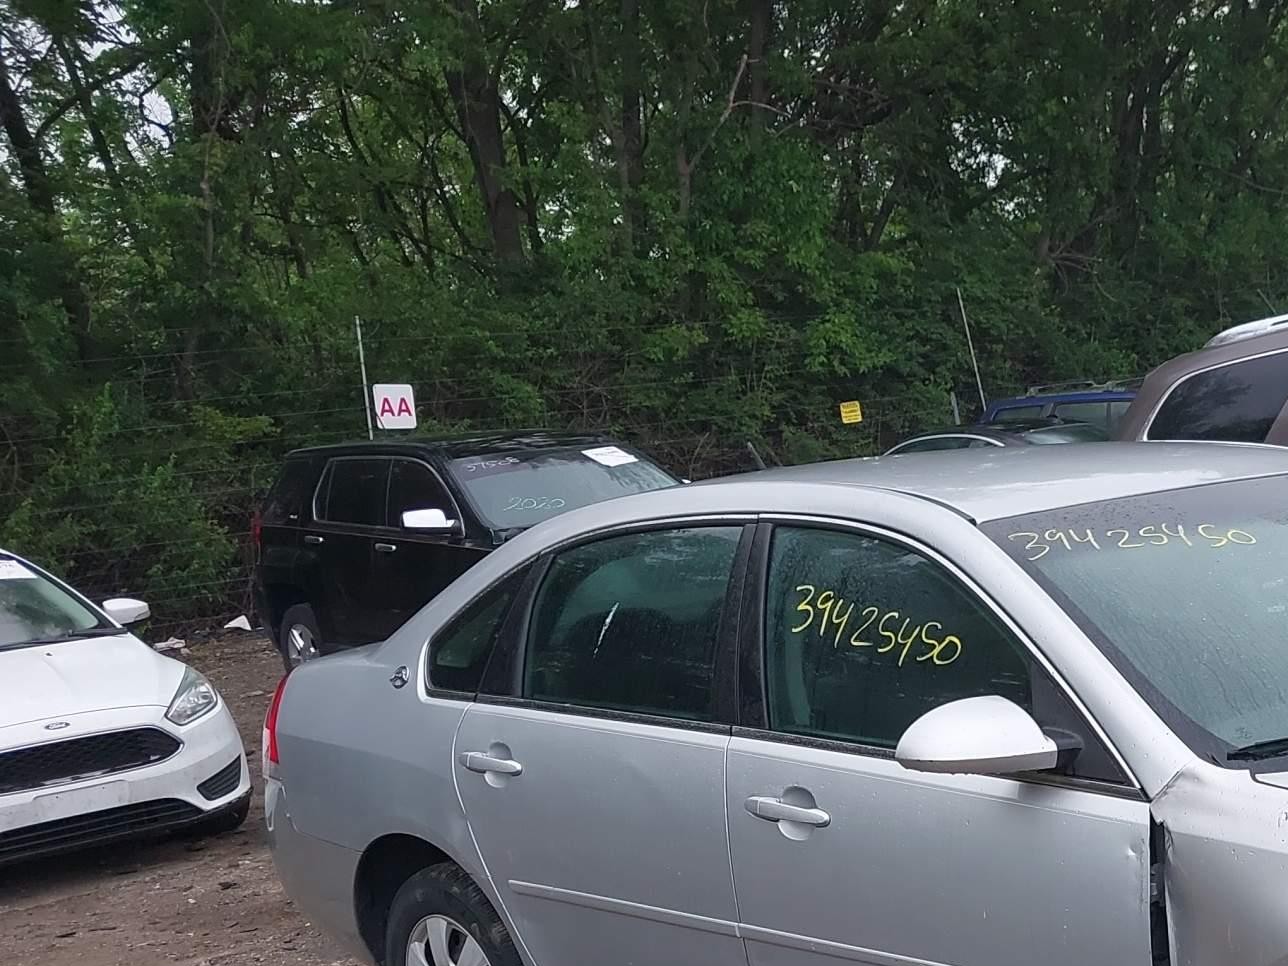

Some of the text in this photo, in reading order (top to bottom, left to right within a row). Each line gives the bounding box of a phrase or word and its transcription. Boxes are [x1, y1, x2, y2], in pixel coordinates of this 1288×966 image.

[380, 397, 413, 417] AA
[1008, 523, 1257, 561] 39425450
[792, 584, 962, 667] 39425450
